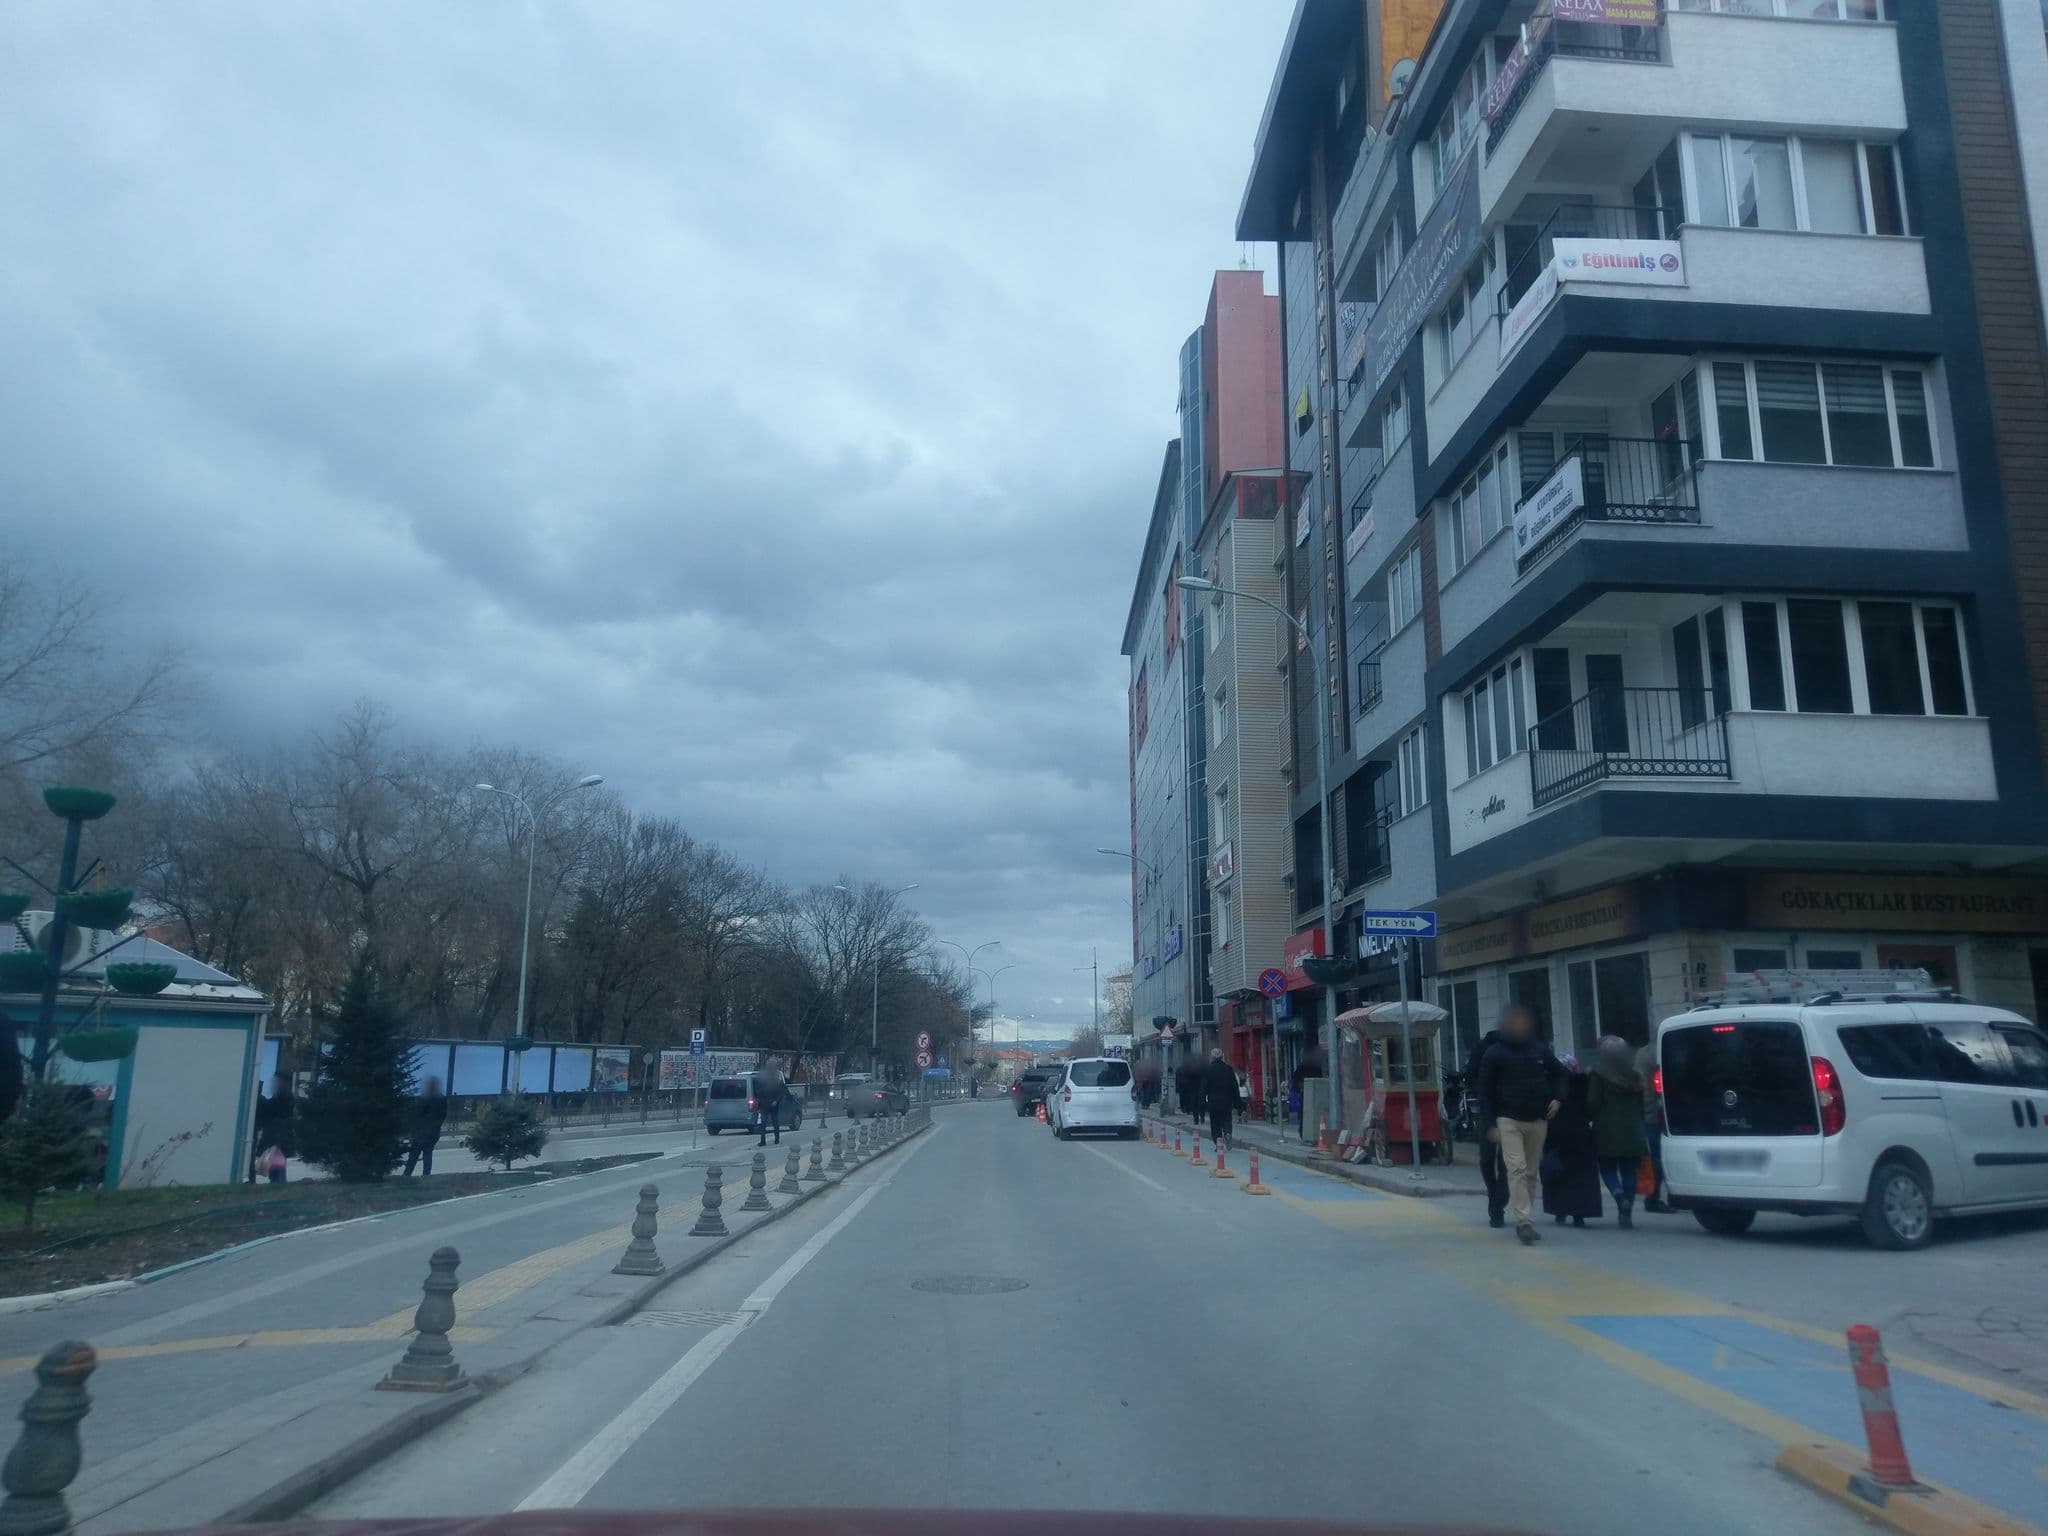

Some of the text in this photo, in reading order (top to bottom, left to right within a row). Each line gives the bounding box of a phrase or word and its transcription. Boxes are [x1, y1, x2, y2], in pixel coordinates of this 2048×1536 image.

[1782, 887, 2036, 914] GÖKAÇIKLAR RESTAURANT
[1369, 918, 1416, 928] TEK YÖN
